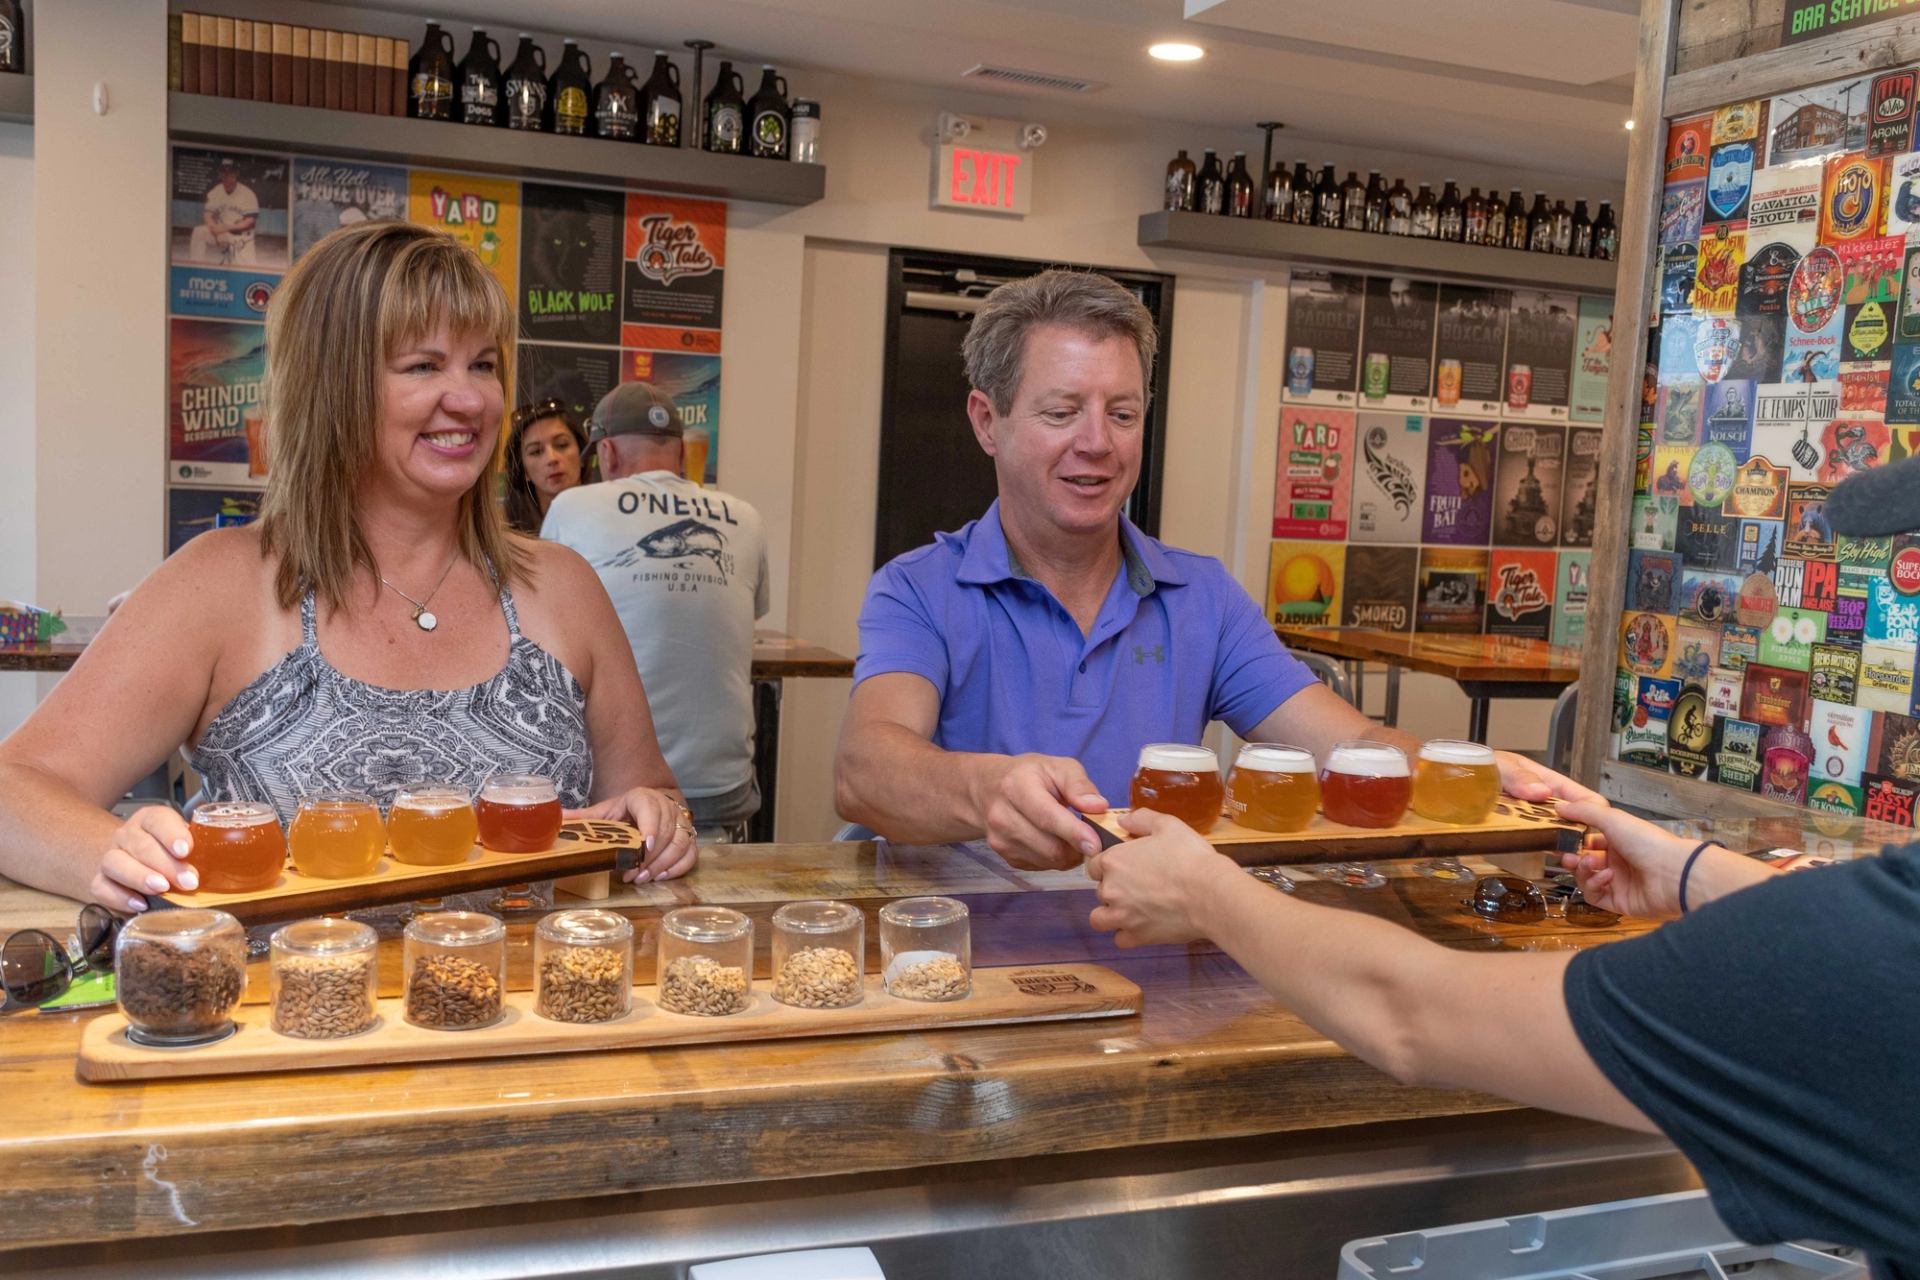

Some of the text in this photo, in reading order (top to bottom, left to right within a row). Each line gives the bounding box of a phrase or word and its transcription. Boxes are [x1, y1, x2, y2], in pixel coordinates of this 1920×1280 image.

[1791, 8, 1826, 35] BAR
[505, 79, 547, 101] SWANS
[1871, 124, 1909, 139] ARONIA
[300, 166, 331, 181] All
[334, 168, 370, 185] Hell
[951, 147, 1021, 208] EXIT
[433, 193, 497, 224] YARD
[1751, 194, 1817, 212] CAVATICA
[1750, 209, 1797, 225] STOUT
[641, 216, 695, 250] Tiger
[671, 242, 707, 265] Tale
[1839, 239, 1900, 254] Mikkeller
[528, 290, 574, 314] BLACK
[578, 291, 615, 313] WOLF
[1294, 309, 1356, 330] PADDLE
[1442, 322, 1502, 344] BOXCAR
[182, 382, 265, 411] CHINOO
[1894, 400, 1917, 408] TOTAL
[1756, 396, 1838, 419] LE TEMPS NOIR
[182, 406, 240, 431] WIND
[1294, 423, 1339, 449] YARD
[1735, 487, 1776, 496] CHAMPION
[618, 491, 738, 526] O'NEILL
[1430, 495, 1462, 512] FRUIT
[1433, 509, 1457, 528] BAT
[1691, 522, 1727, 535] BELLE
[1741, 550, 1756, 561] ALE
[1838, 542, 1860, 563] Sky
[1860, 541, 1890, 563] High
[1896, 560, 1920, 571] SUPE
[632, 573, 729, 586] FISHING DIVISION
[1500, 566, 1536, 593] Tiger
[1570, 565, 1590, 588] YA
[1775, 565, 1805, 589] DUN
[1803, 560, 1838, 600] IPA
[1519, 586, 1543, 603] Tale
[1839, 597, 1866, 614] HOP
[1274, 612, 1331, 625] RADIANT
[1348, 604, 1407, 629] SMOKED
[1828, 613, 1864, 630] HEAD
[1887, 615, 1919, 629] PONY
[1887, 628, 1917, 639] CLUB
[1865, 667, 1911, 685] Hoegaarden
[1889, 682, 1899, 691] Cru
[1727, 723, 1756, 737] BLACK
[1721, 769, 1750, 783] SHEEP
[1868, 787, 1914, 809] SASSY
[1865, 800, 1913, 828] RED
